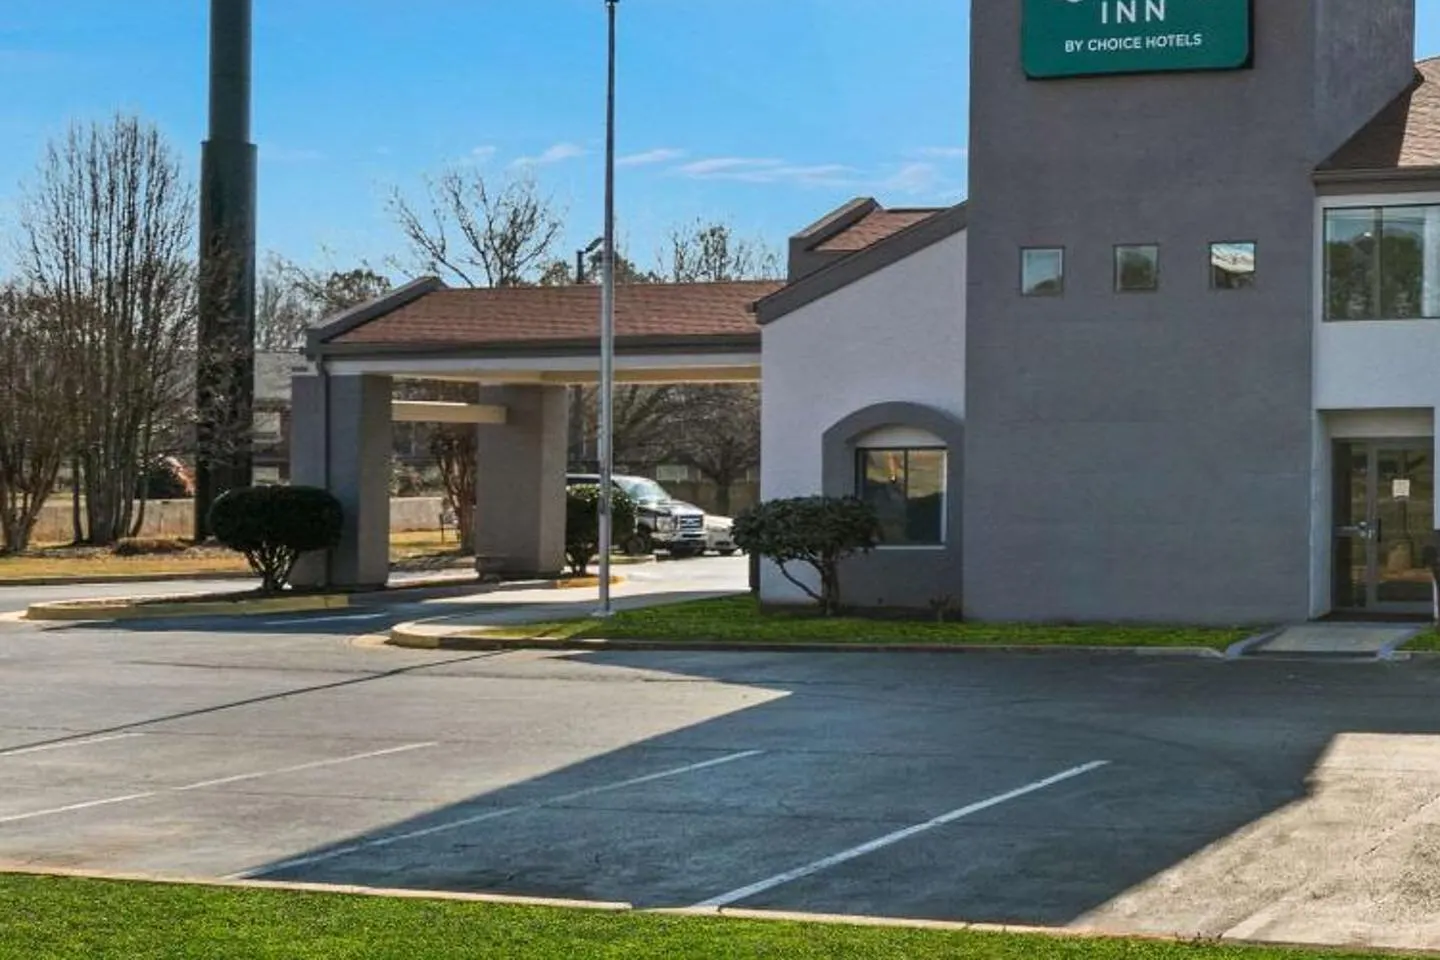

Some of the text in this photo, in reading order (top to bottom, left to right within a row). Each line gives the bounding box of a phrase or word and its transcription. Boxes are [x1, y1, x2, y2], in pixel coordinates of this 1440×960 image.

[1064, 33, 1202, 53] BY CHOICE HOTELS
